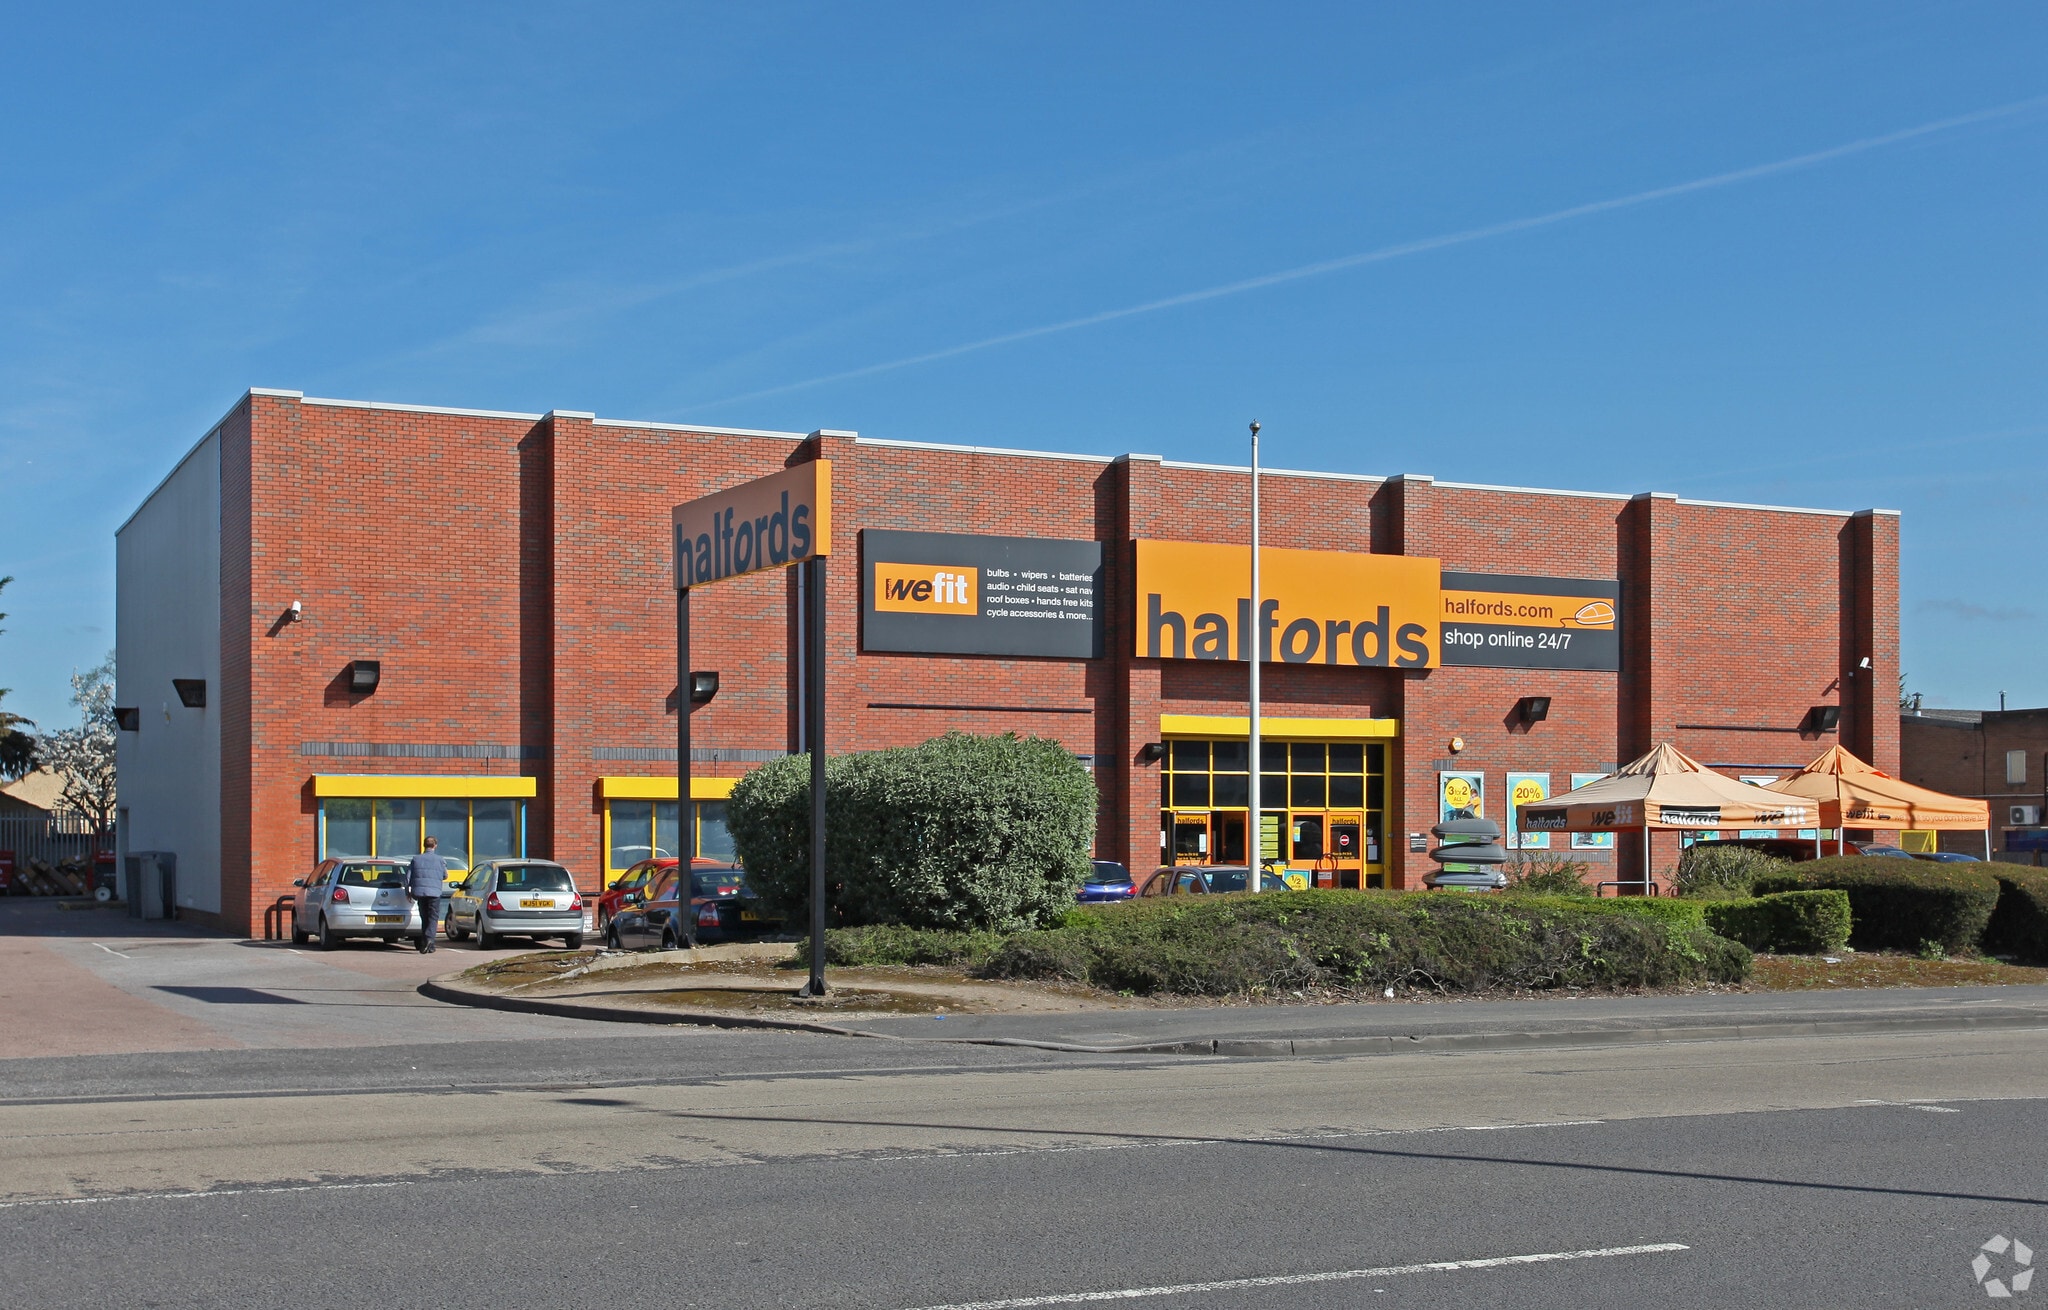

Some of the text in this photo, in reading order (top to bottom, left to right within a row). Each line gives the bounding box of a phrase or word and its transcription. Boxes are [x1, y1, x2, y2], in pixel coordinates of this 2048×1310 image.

[676, 490, 811, 589] halfords
[986, 568, 1093, 582] bulbs wipers batteries
[885, 572, 968, 604] wefit
[986, 582, 1093, 595] audio child seats sat nav
[986, 595, 1093, 608] roof boxes hands free kits
[1445, 598, 1553, 618] halfords.com
[986, 608, 1093, 620] cycle accessories & more...
[1147, 593, 1430, 668] halfords
[1445, 628, 1571, 650] shop online 24/7
[1448, 786, 1454, 795] 3
[1462, 786, 1468, 795] 2
[1516, 787, 1540, 799] 20%
[1591, 805, 1632, 826] wefit
[1846, 808, 1874, 820] wefit
[1526, 816, 1566, 829] halfords
